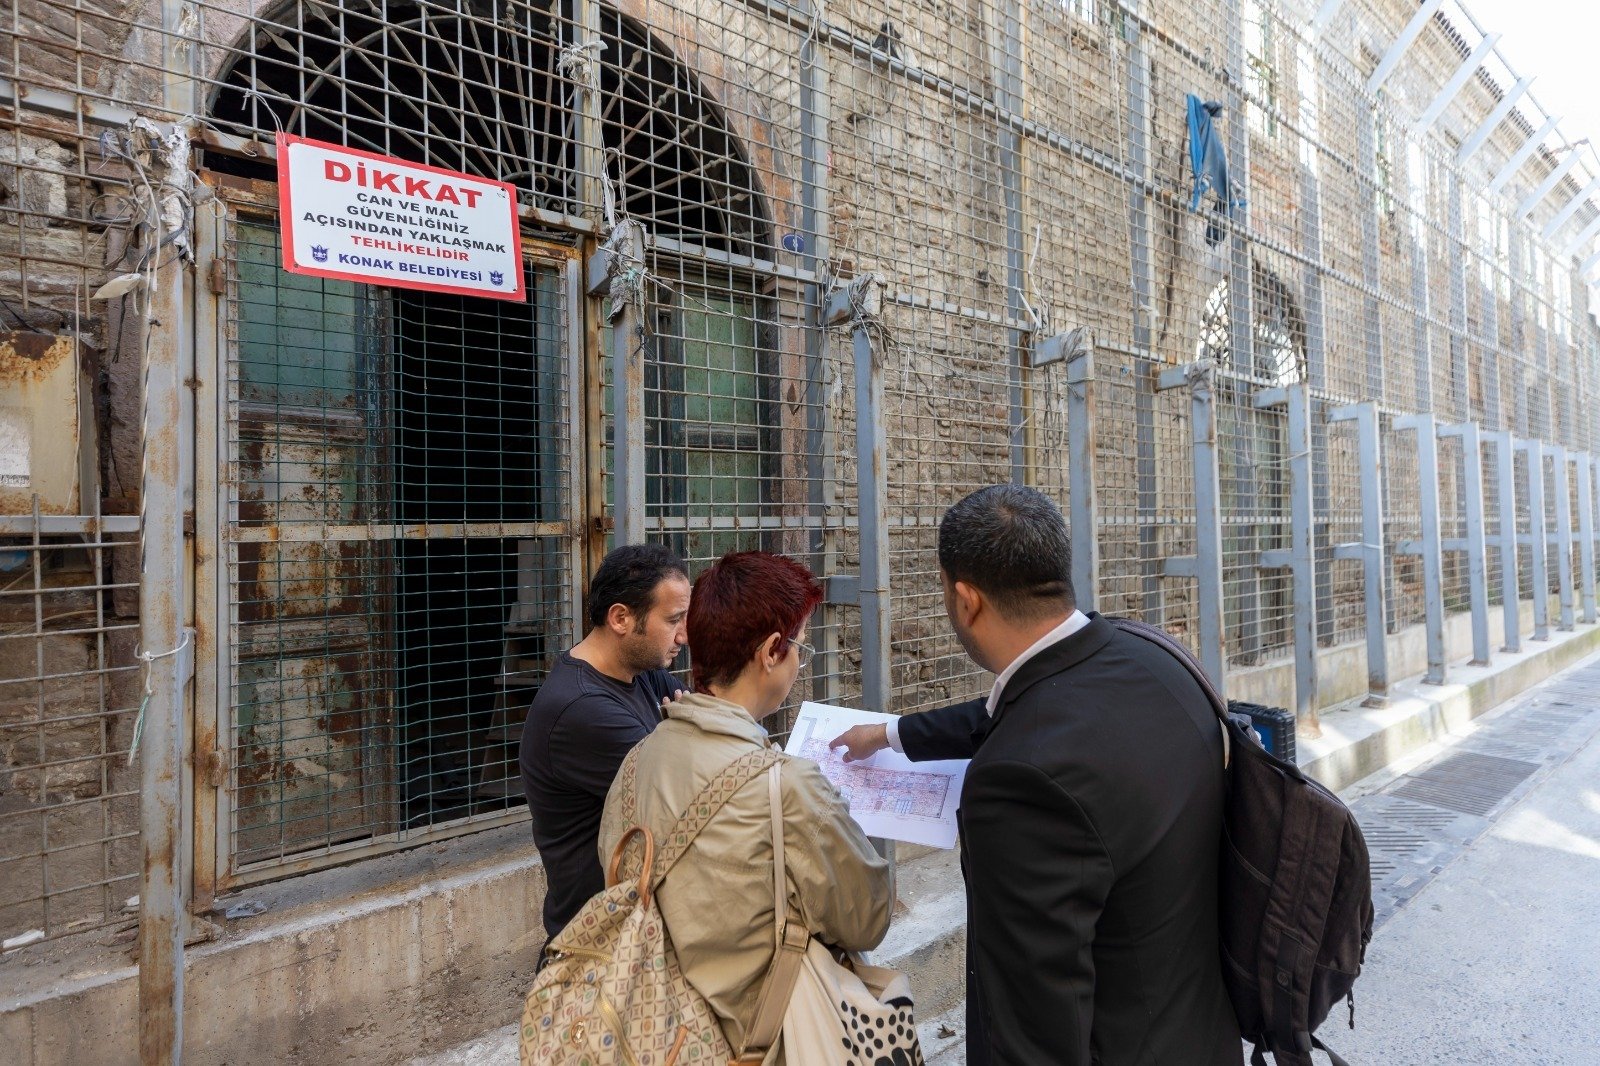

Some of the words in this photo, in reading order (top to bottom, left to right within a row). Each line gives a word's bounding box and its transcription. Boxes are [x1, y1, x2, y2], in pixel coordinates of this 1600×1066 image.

[325, 160, 483, 208] DİKKAT
[346, 205, 470, 235] GÜVENLİĞİNİZ
[357, 193, 393, 207] CAN
[399, 201, 420, 213] VE
[426, 205, 459, 220] MAL
[303, 212, 403, 238] AÇISINDAN
[409, 231, 506, 254] YAKLAŞMAK
[350, 235, 470, 262] TEHLİKELİDİR
[338, 253, 394, 271] KONAK
[399, 262, 483, 282] BELEDİYESİ
